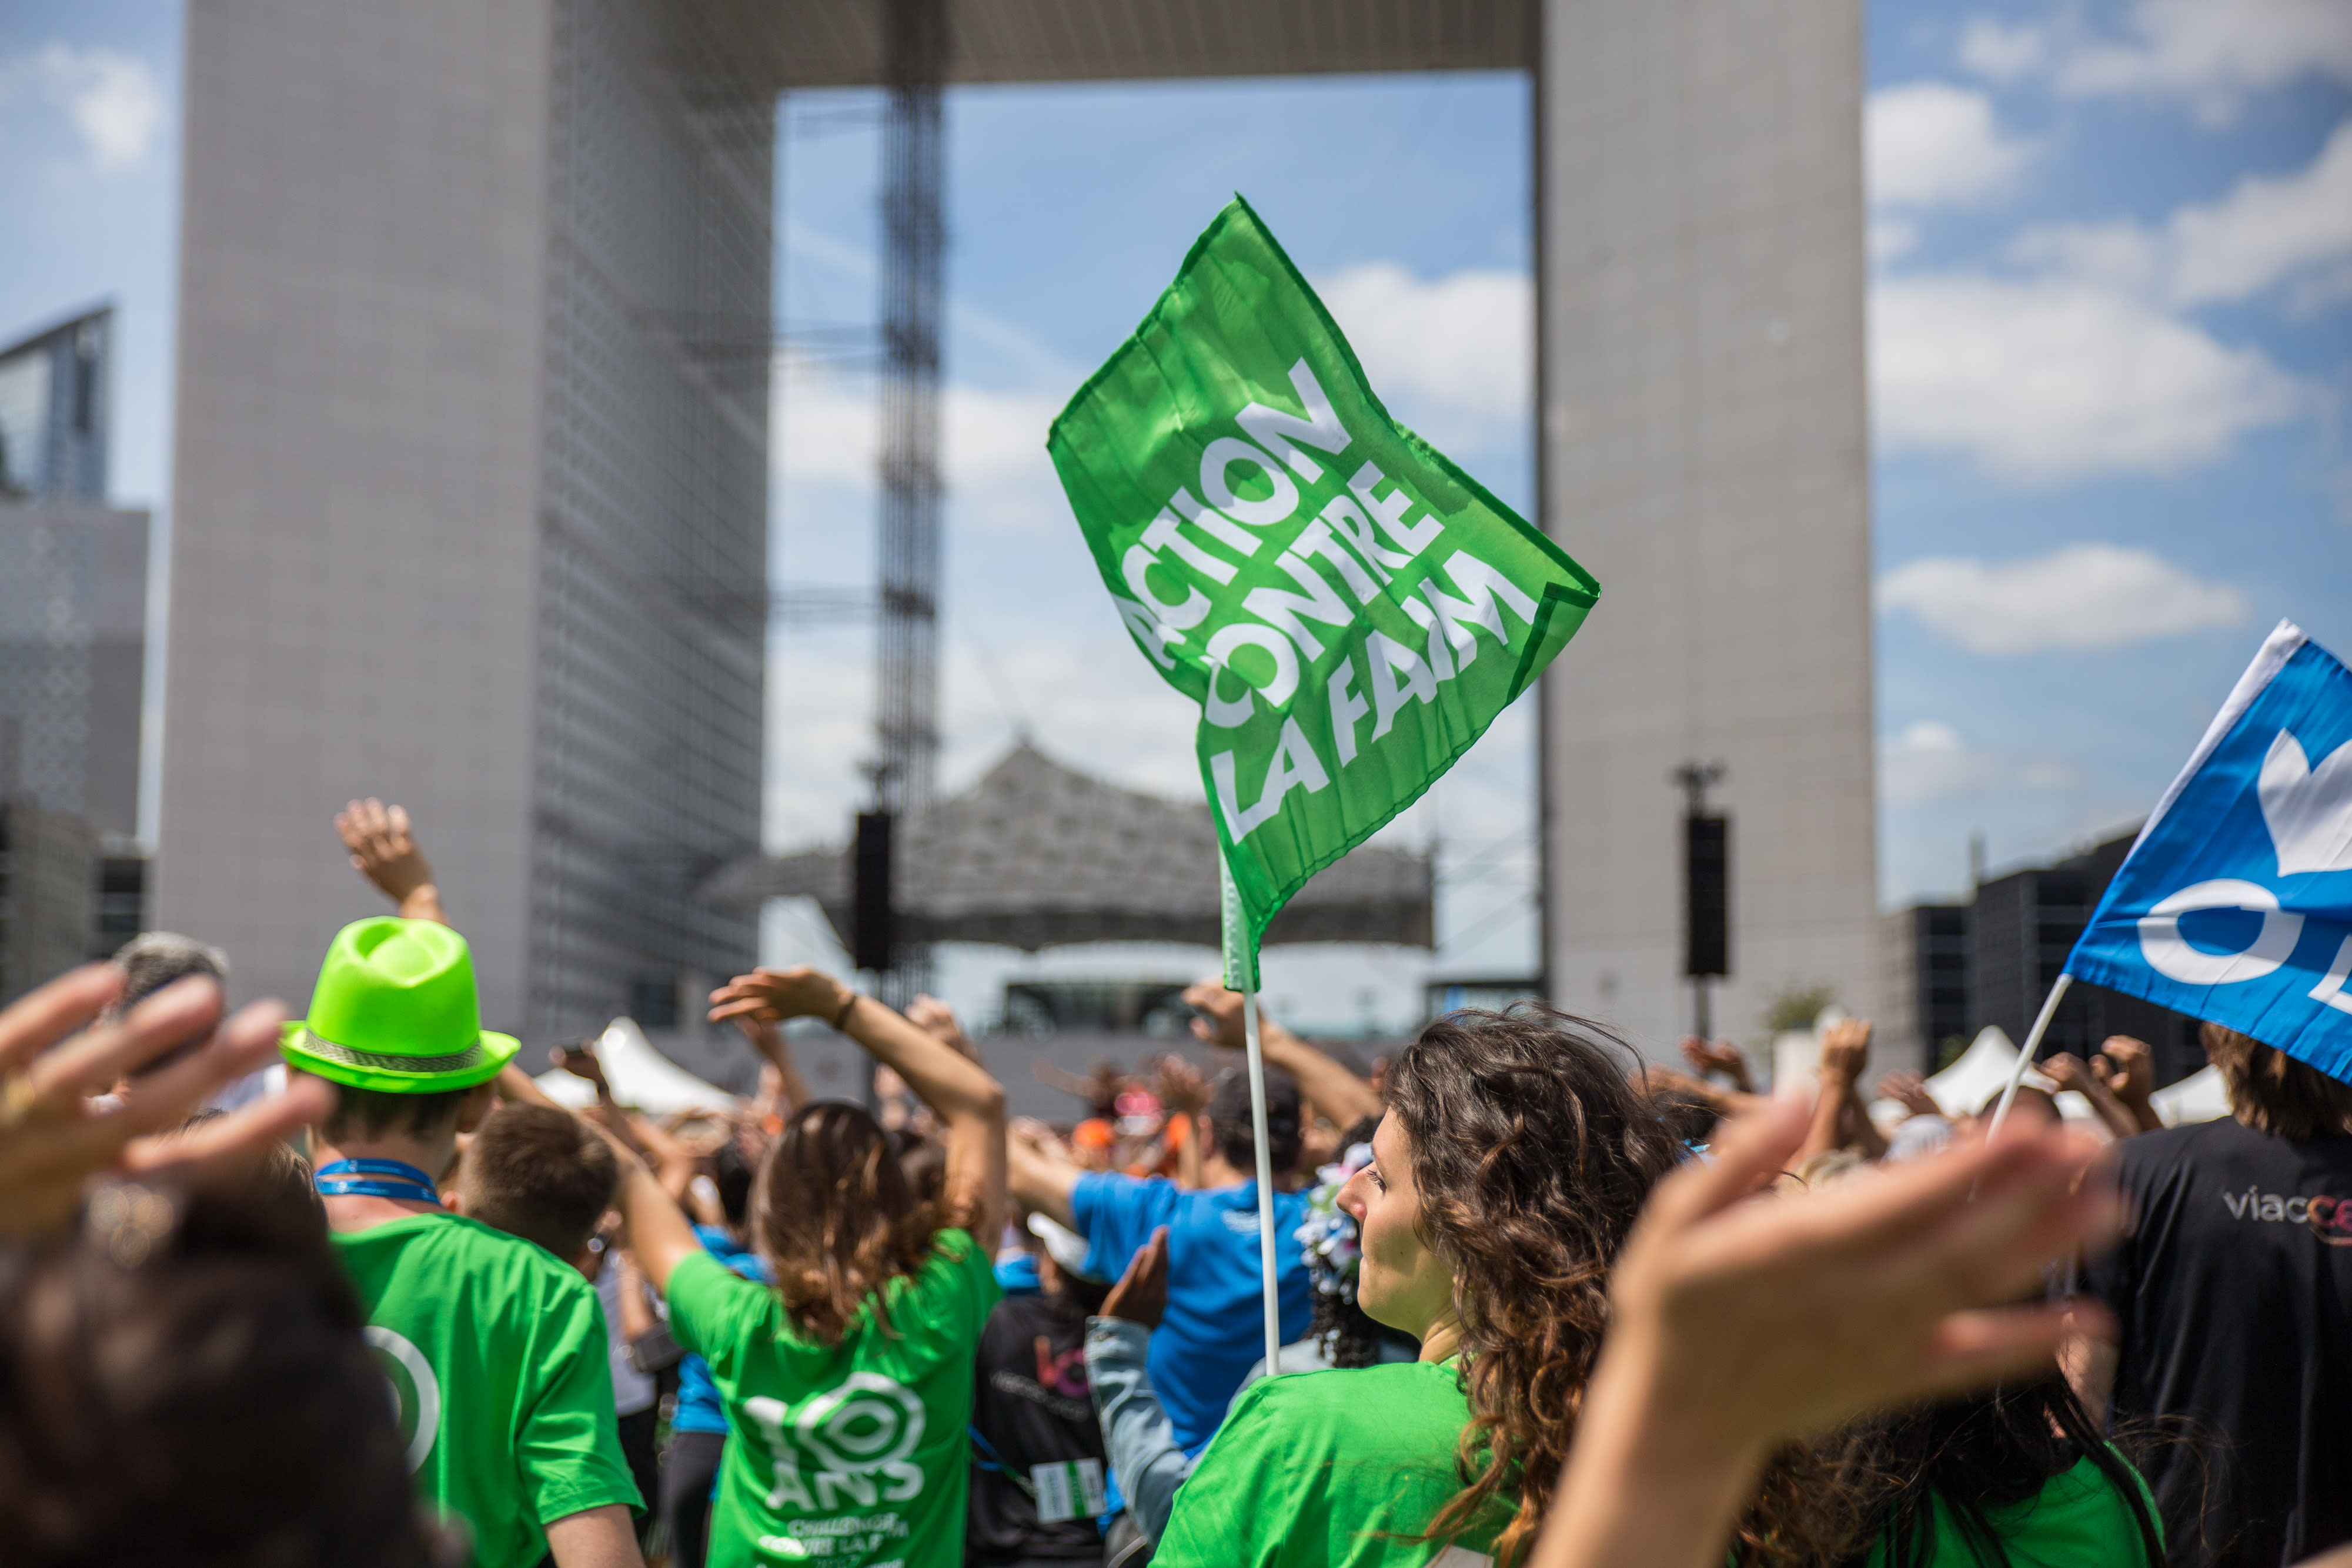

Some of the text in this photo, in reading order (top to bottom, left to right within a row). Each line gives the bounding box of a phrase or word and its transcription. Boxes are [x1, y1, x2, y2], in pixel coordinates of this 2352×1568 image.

[1111, 357, 1352, 671] ACTION
[1200, 460, 1445, 728] CONTRE
[1210, 549, 1539, 845] LA FAIM
